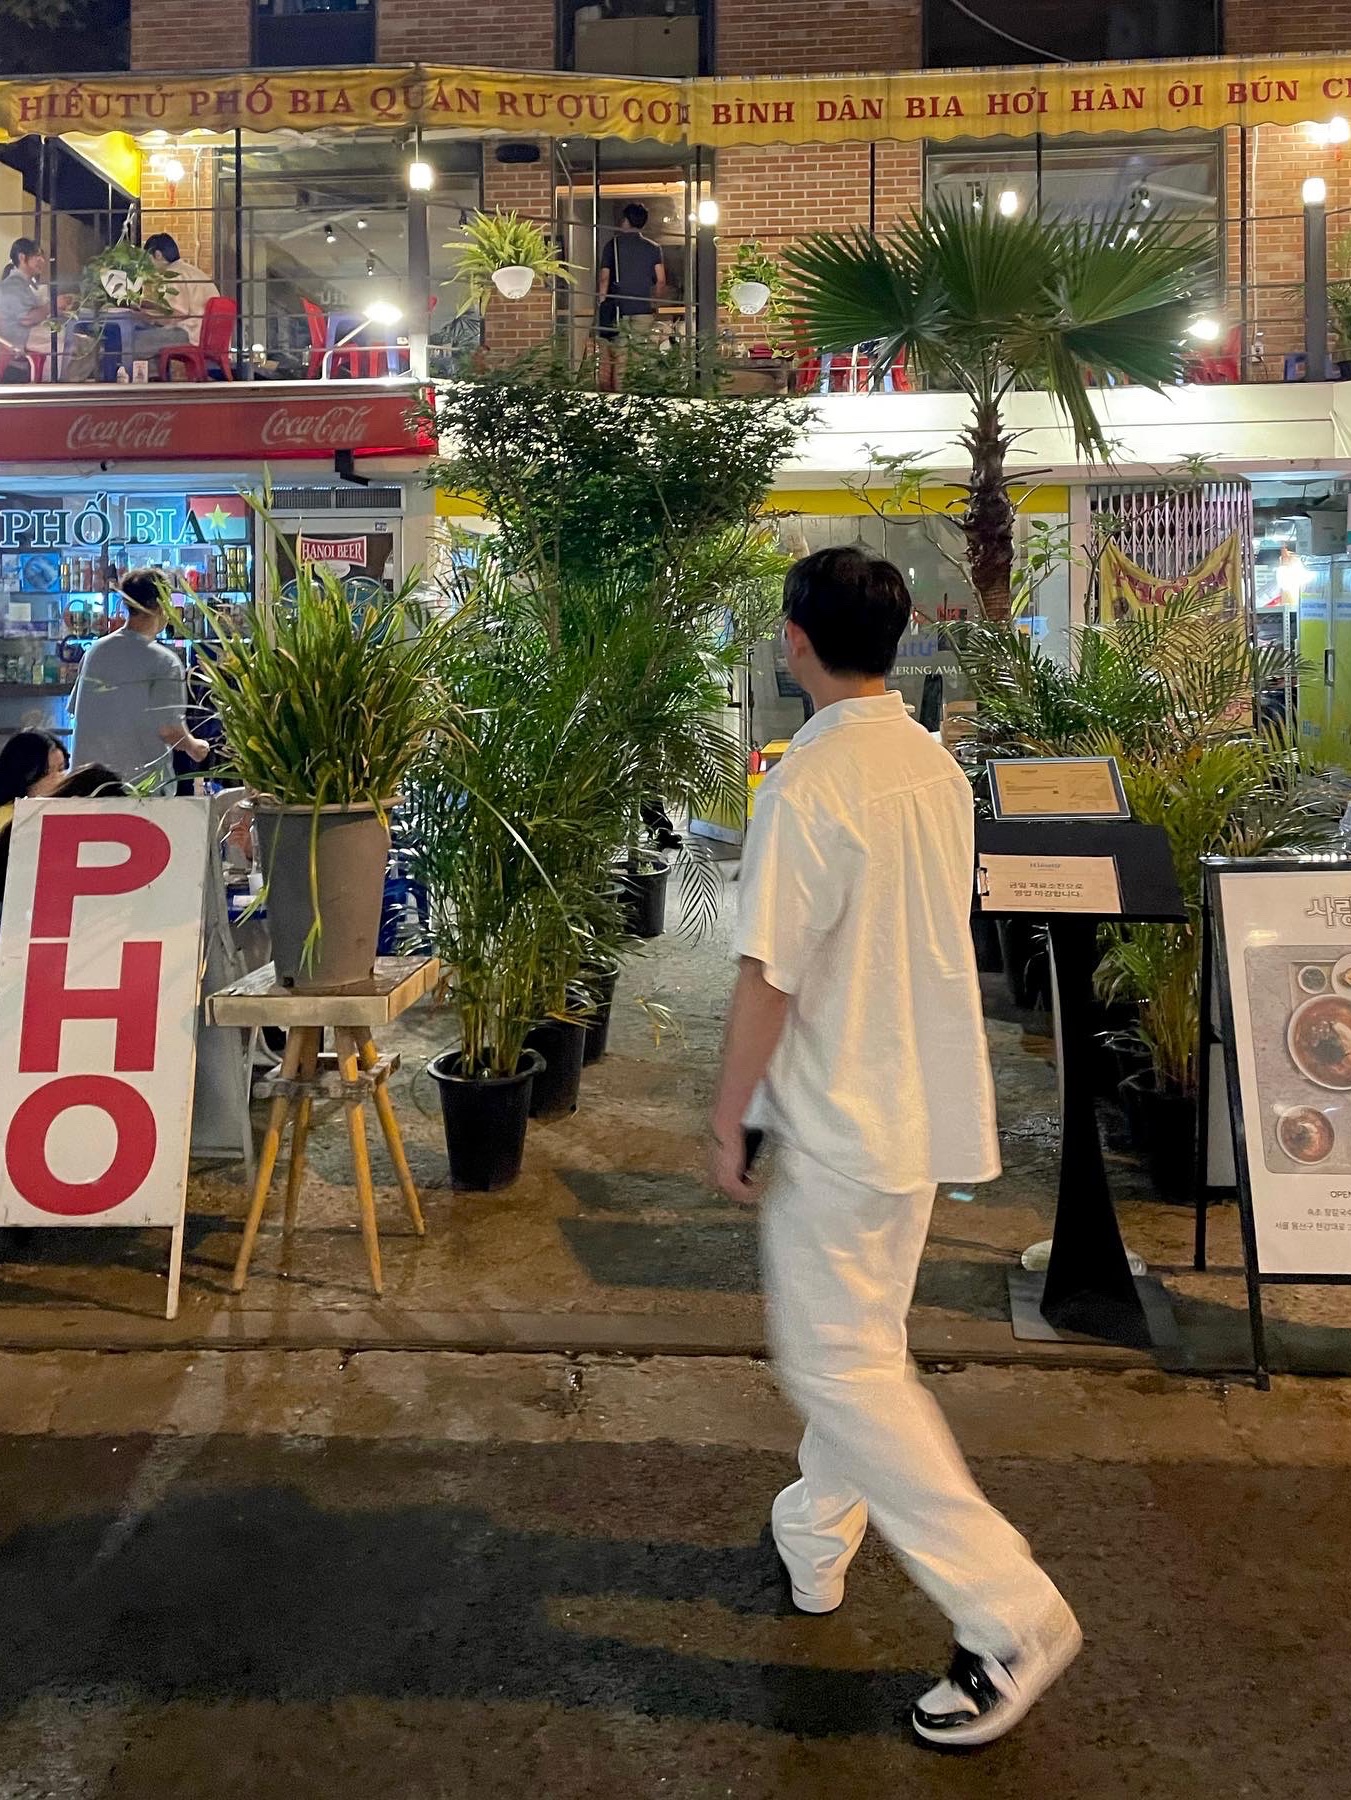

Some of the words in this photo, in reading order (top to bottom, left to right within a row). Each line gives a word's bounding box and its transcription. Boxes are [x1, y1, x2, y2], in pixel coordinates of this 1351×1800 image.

[189, 77, 273, 117] PHỐ
[289, 88, 354, 115] BIA
[494, 91, 610, 127] RƯỢU
[711, 98, 796, 125] BÌNH
[816, 94, 884, 122] DÂN
[905, 95, 965, 119] BIA
[1070, 82, 1146, 112] HÀN
[1226, 75, 1300, 104] BÚN
[66, 411, 179, 449] Coca-Cola
[261, 405, 374, 446] Coca-Cola
[0, 491, 112, 548] PHỐ
[124, 508, 211, 546] BIA
[302, 542, 335, 560] HANOI
[336, 541, 364, 561] BEER
[5, 813, 171, 1216] PHO
